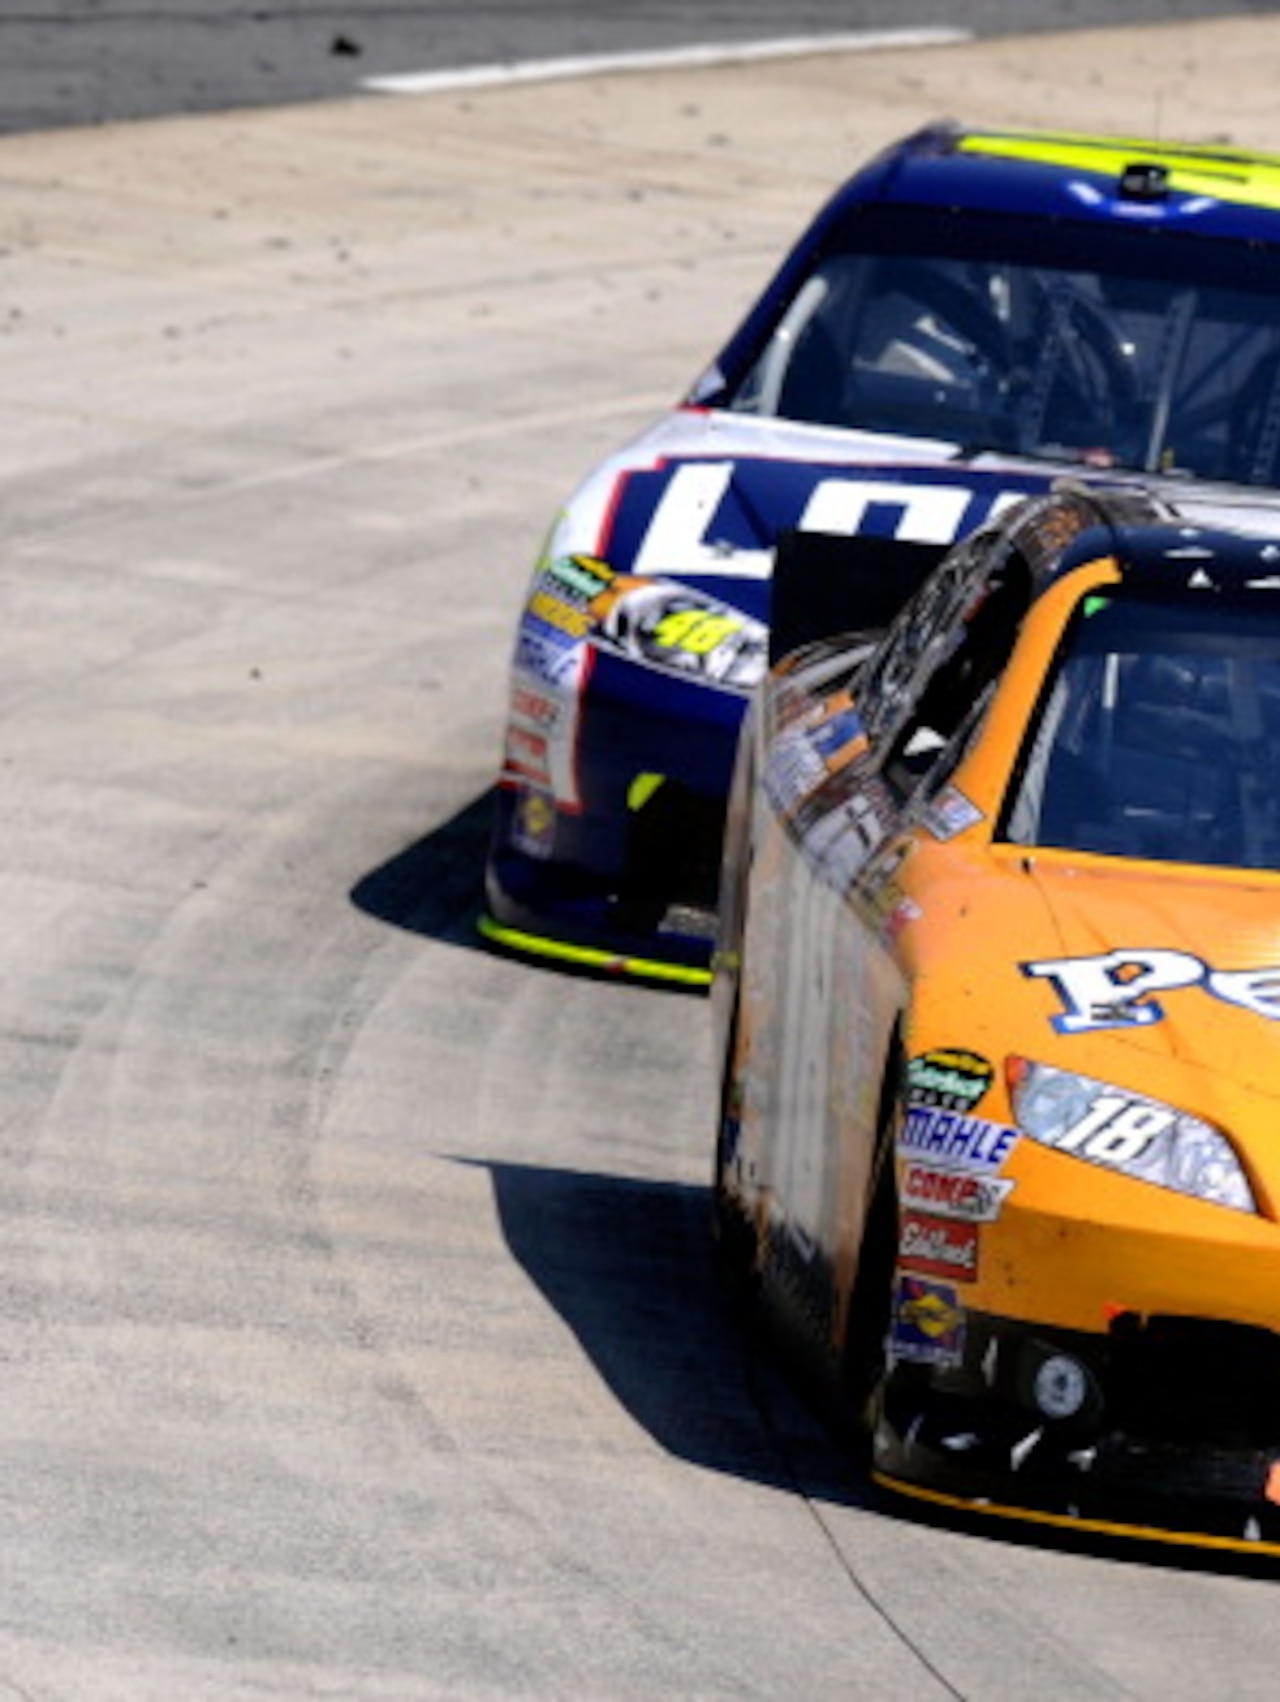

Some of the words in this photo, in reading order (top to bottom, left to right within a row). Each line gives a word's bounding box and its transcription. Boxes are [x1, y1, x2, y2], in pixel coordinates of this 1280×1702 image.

[632, 461, 1028, 580] LO
[902, 1108, 1017, 1163] MAHLE
[1053, 1096, 1179, 1162] 18
